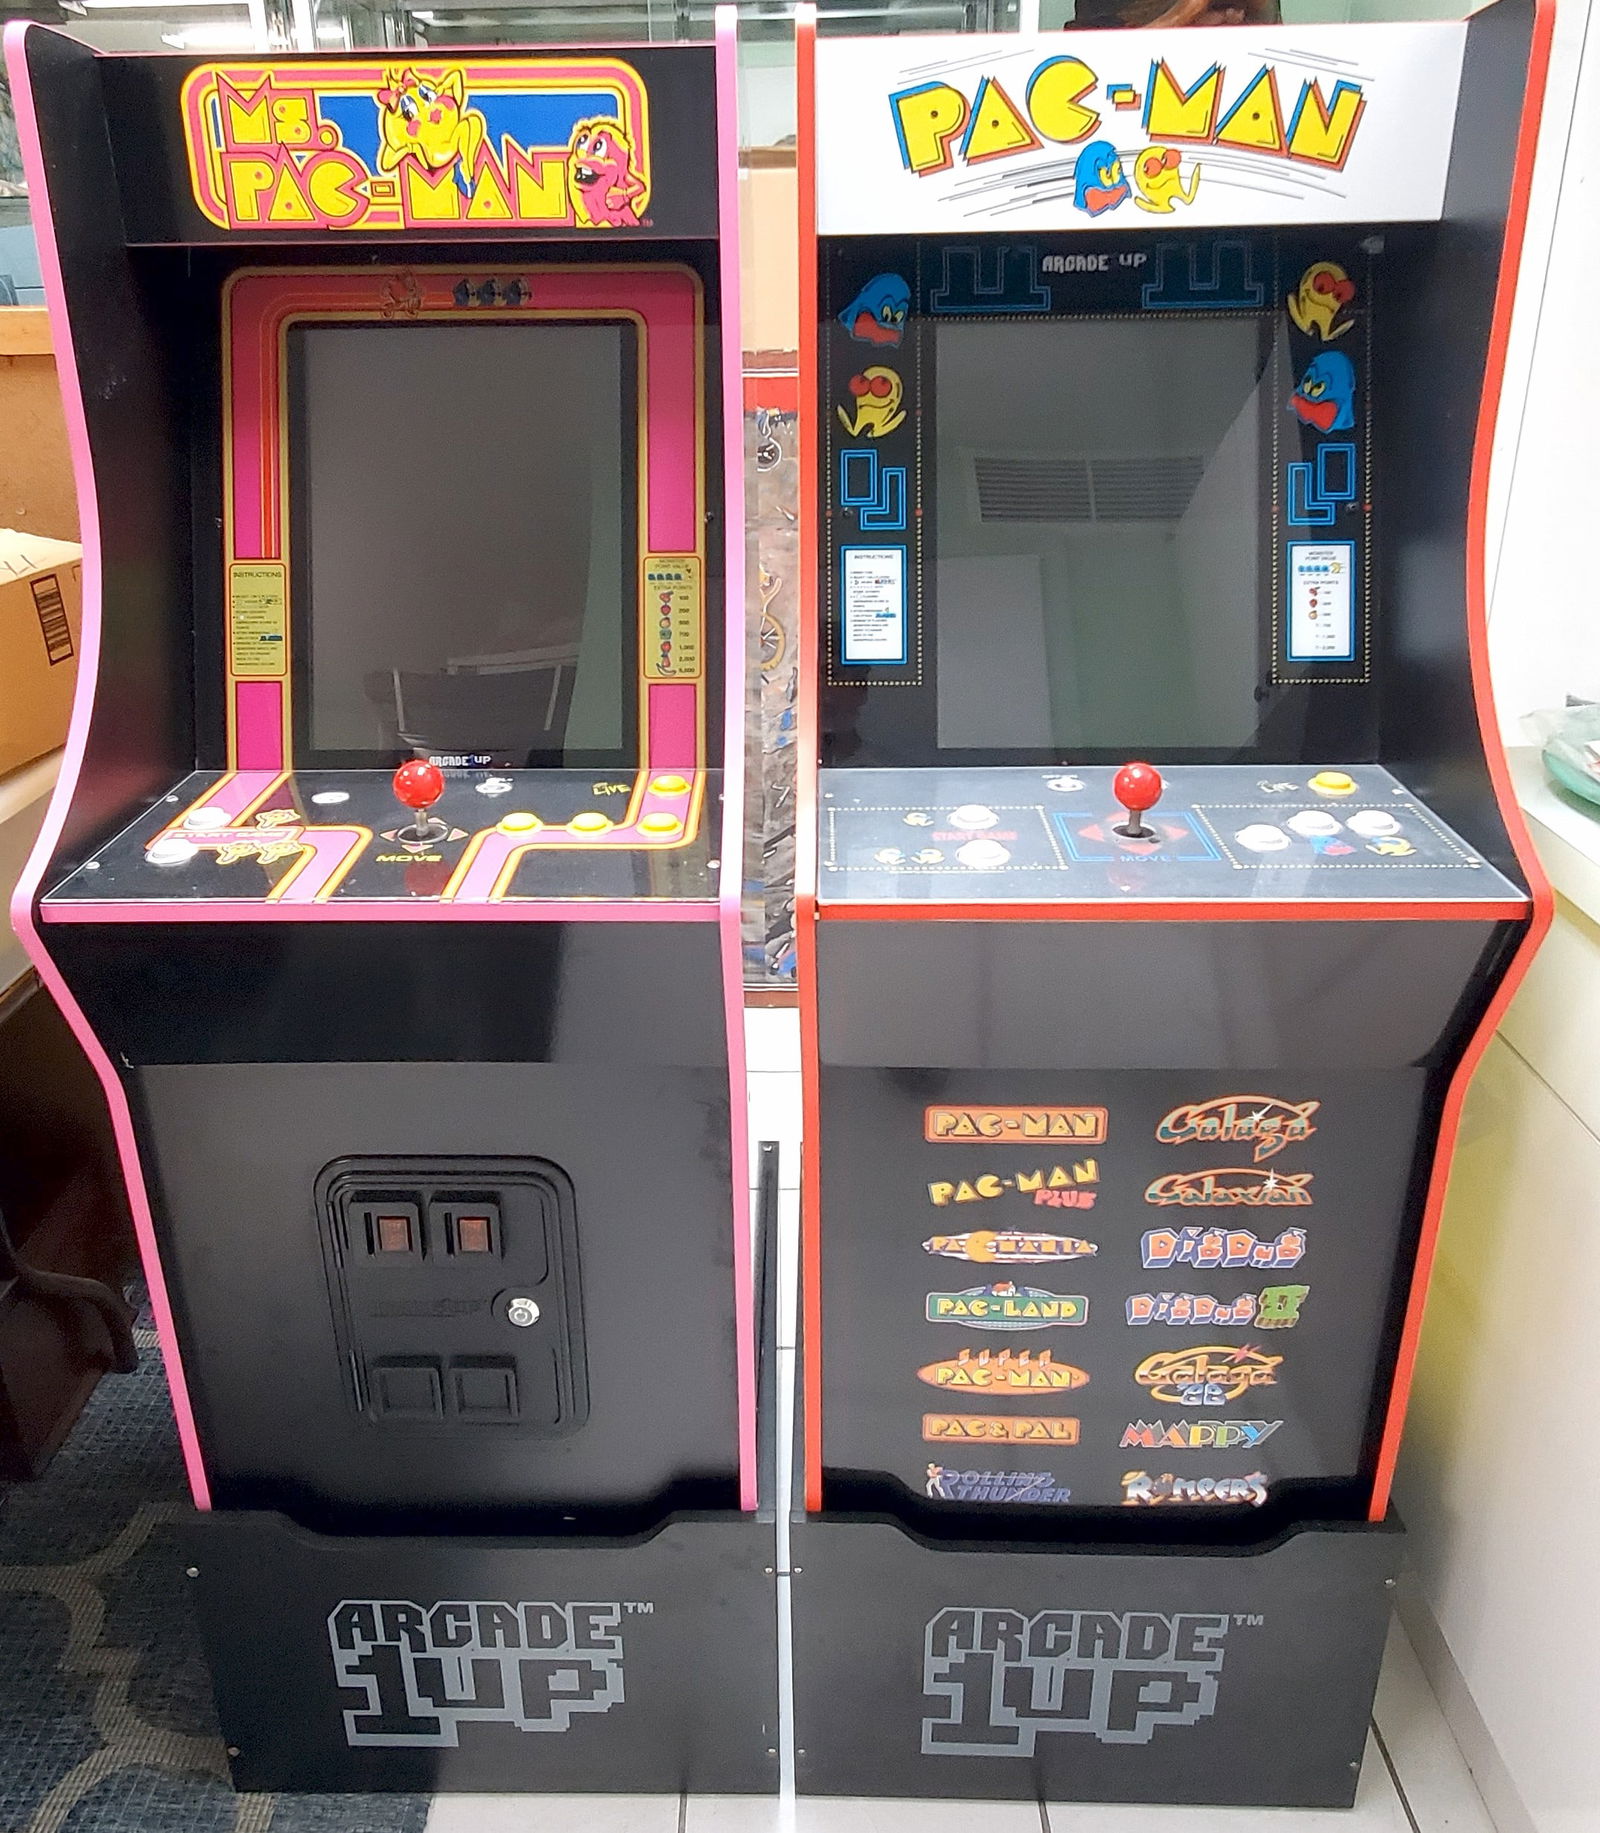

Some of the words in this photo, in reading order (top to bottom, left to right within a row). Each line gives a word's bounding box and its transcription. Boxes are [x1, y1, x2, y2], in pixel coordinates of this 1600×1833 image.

[889, 55, 1366, 177] PAC-MAN
[222, 142, 575, 228] PAC-MAN
[1042, 254, 1109, 273] ARCADE
[375, 854, 443, 862] MOVE
[934, 1111, 1098, 1138] PAC-MAN
[928, 1157, 1100, 1207] PAC-MAN
[1144, 1168, 1315, 1206] Galaxian
[1033, 1189, 1098, 1210] PLUS
[937, 1298, 1078, 1319] PAC-LAND
[957, 1347, 1053, 1367] SUPER
[936, 1367, 1073, 1388] PAC-MAN
[1134, 1345, 1285, 1400] Galaga
[929, 1418, 986, 1438] PAC
[989, 1421, 1009, 1439] &
[1013, 1420, 1072, 1440] PAL
[1119, 1419, 1284, 1448] MAPPY
[939, 1469, 1056, 1499] ROLLING
[957, 1485, 1071, 1503] THUNDER
[328, 1600, 623, 1653] ARCADE
[925, 1607, 1229, 1663] ARCADE
[338, 1644, 624, 1747] 1UP
[921, 1652, 1218, 1757] 1UP
